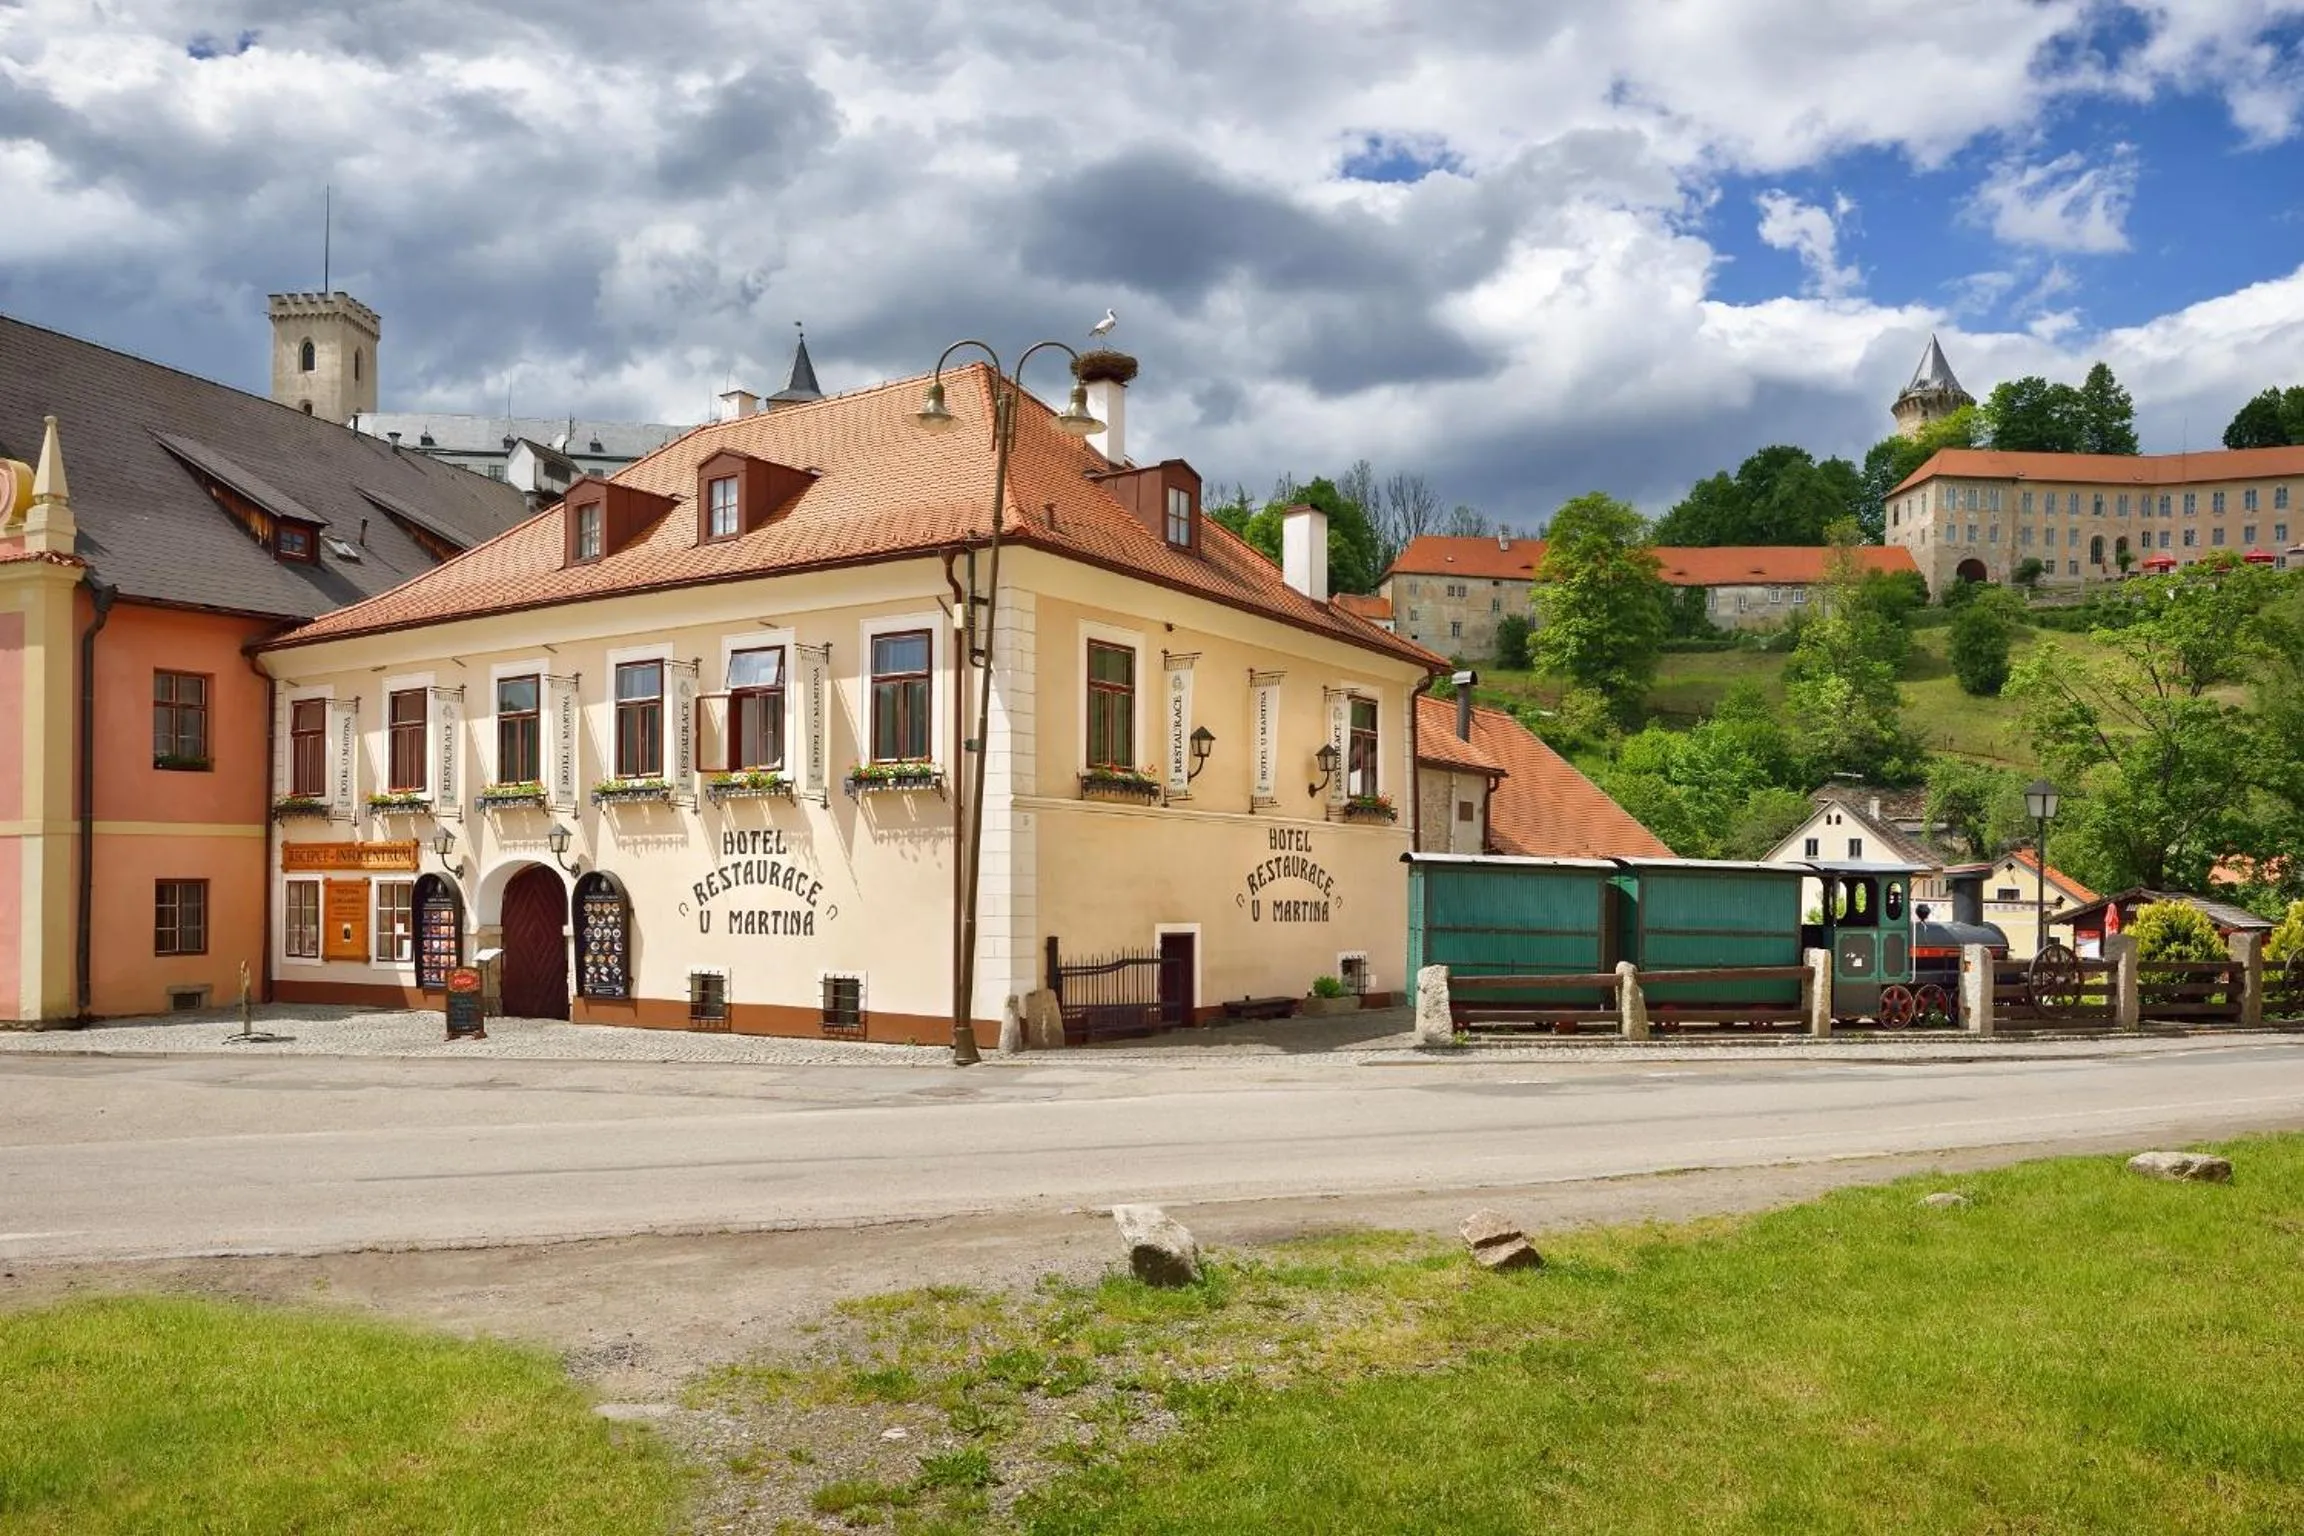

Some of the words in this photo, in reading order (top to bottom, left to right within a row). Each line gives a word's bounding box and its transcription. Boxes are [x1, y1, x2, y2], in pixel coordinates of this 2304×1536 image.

[680, 701, 689, 778] RESTAURACE
[1173, 694, 1182, 773] RESTAURACE
[443, 722, 453, 791] RESTAURACE
[288, 850, 329, 863] RECEPCE
[336, 847, 411, 862] INFOCENTRUM
[723, 829, 787, 855] HOTEL
[1269, 828, 1312, 852] HOTEL
[693, 860, 823, 907] RESTAURACE
[1247, 856, 1334, 898] RESTAURACE
[699, 910, 711, 934] U
[728, 910, 815, 936] MARTINA
[1251, 900, 1260, 922] U
[1272, 900, 1329, 922] MARTINA
